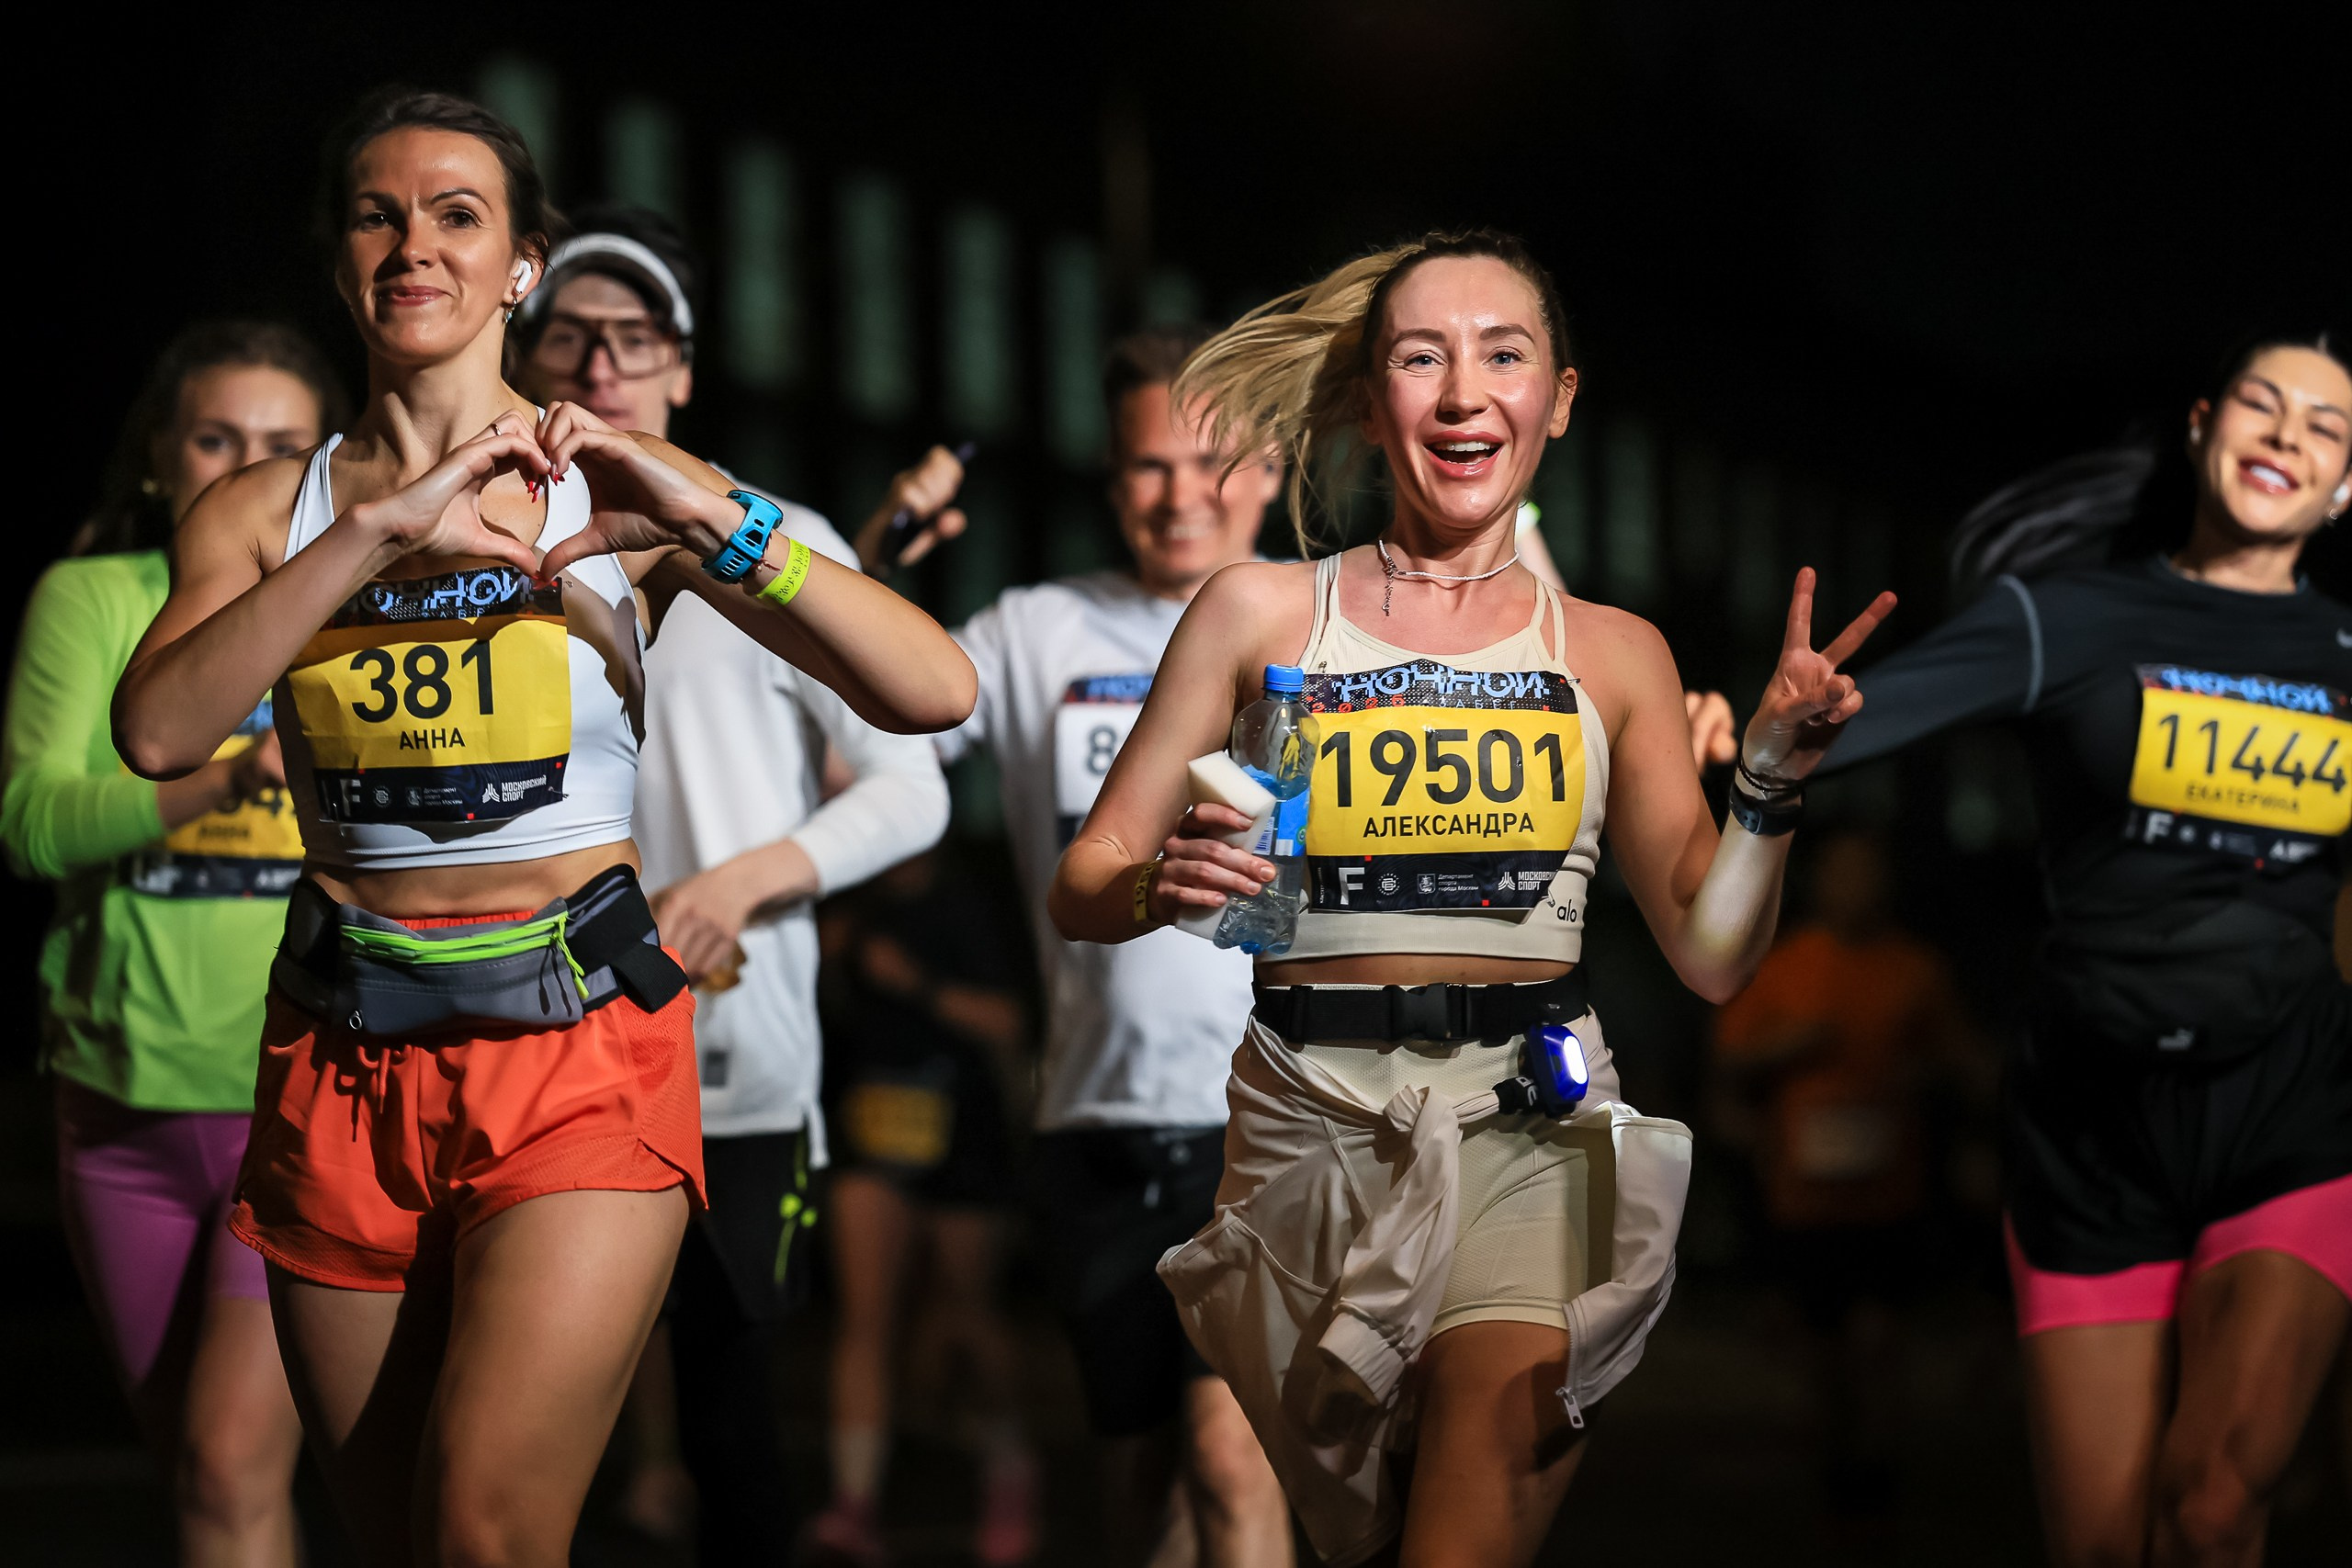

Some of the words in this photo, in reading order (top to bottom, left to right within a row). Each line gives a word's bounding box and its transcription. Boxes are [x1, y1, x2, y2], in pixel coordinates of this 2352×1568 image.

[349, 639, 494, 723] 381
[399, 727, 466, 750] АННА
[2159, 714, 2347, 795] 11444
[1320, 728, 1566, 808] 19501
[501, 774, 547, 792] МОСКОВСКИЙ
[502, 790, 525, 803] СПОРТ
[1363, 812, 1535, 839] АЛЕКСАНДРА
[1338, 866, 1365, 905] F
[1518, 881, 1541, 891] СПОРТ
[1556, 898, 1577, 923] alo
